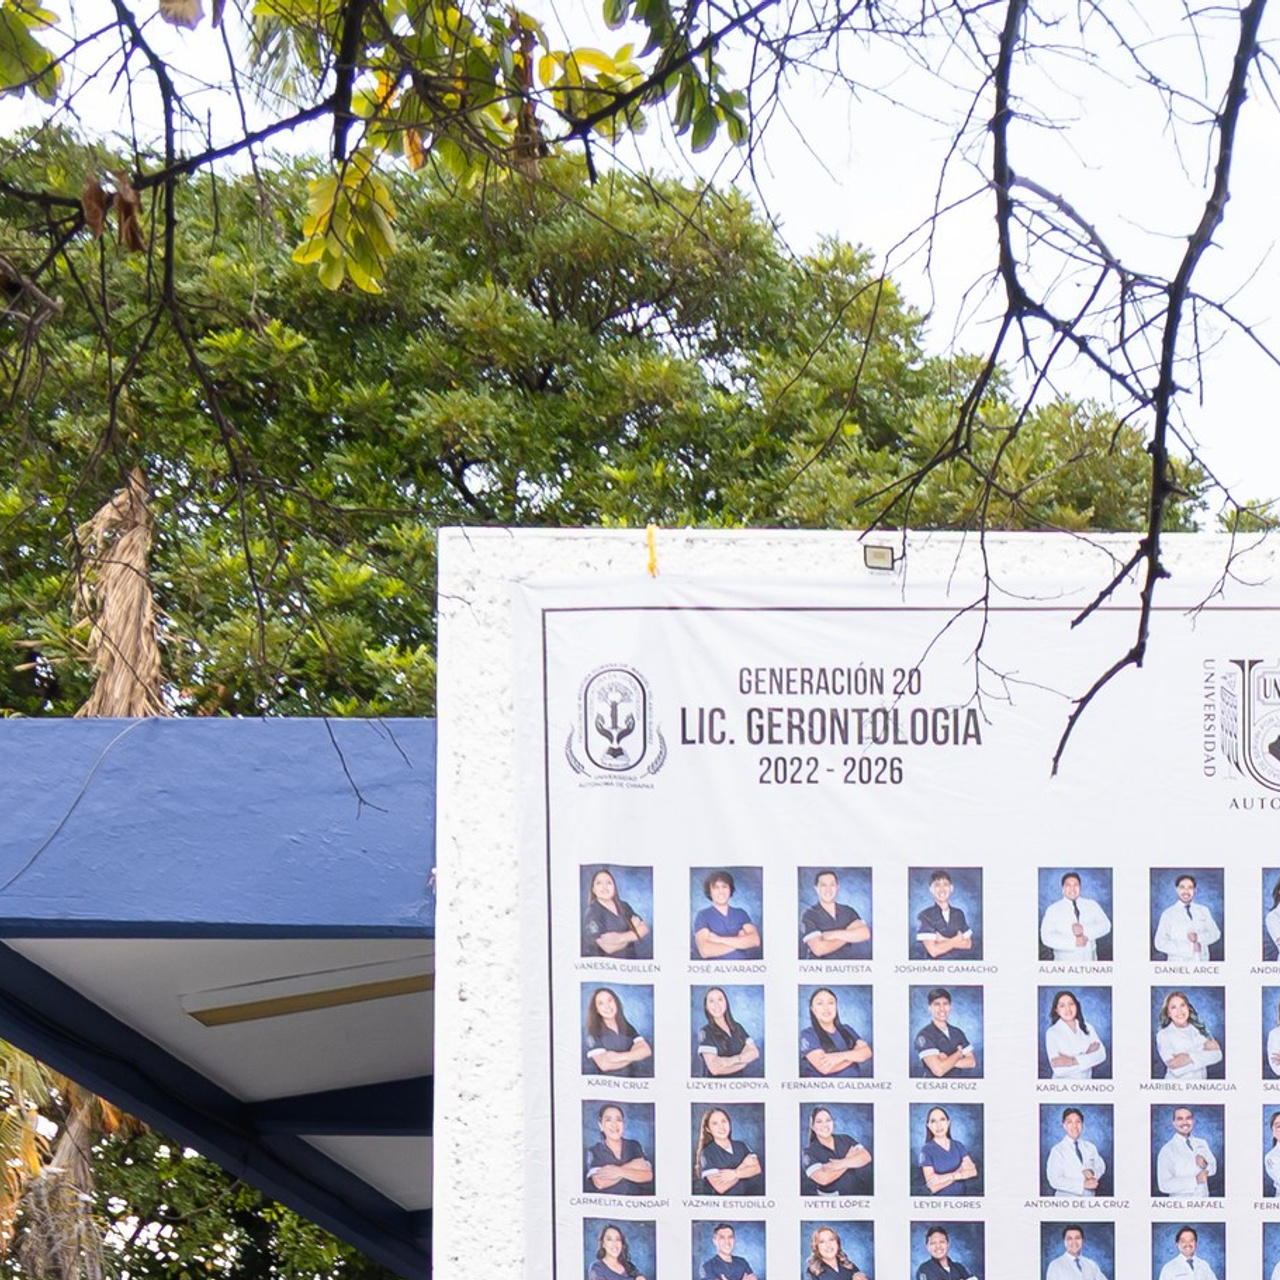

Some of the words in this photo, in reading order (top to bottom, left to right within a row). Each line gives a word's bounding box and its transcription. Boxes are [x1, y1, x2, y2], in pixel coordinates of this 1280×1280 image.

[739, 662, 884, 695] GENERACIÓN
[893, 666, 921, 695] 20
[1203, 659, 1216, 777] UNIVERSIDAD
[680, 707, 735, 745] LIC.
[747, 706, 982, 746] GERONTOLOGIA
[759, 756, 819, 784] 2022
[843, 756, 903, 785] 2026
[687, 965, 711, 973] JOSÉ
[714, 965, 767, 973] ALVARADO
[895, 965, 945, 973] JOSHIMAR
[1068, 966, 1113, 974] ALTUNAR
[950, 1082, 977, 1090] CRUZ
[1036, 1084, 1068, 1092] KARLA
[1071, 1084, 1114, 1092] OVANDO
[723, 1200, 775, 1208] ESTUDILLO
[1024, 1200, 1069, 1208] ANTONIO
[1072, 1200, 1085, 1209] DE
[1103, 1200, 1130, 1208] CRUZ
